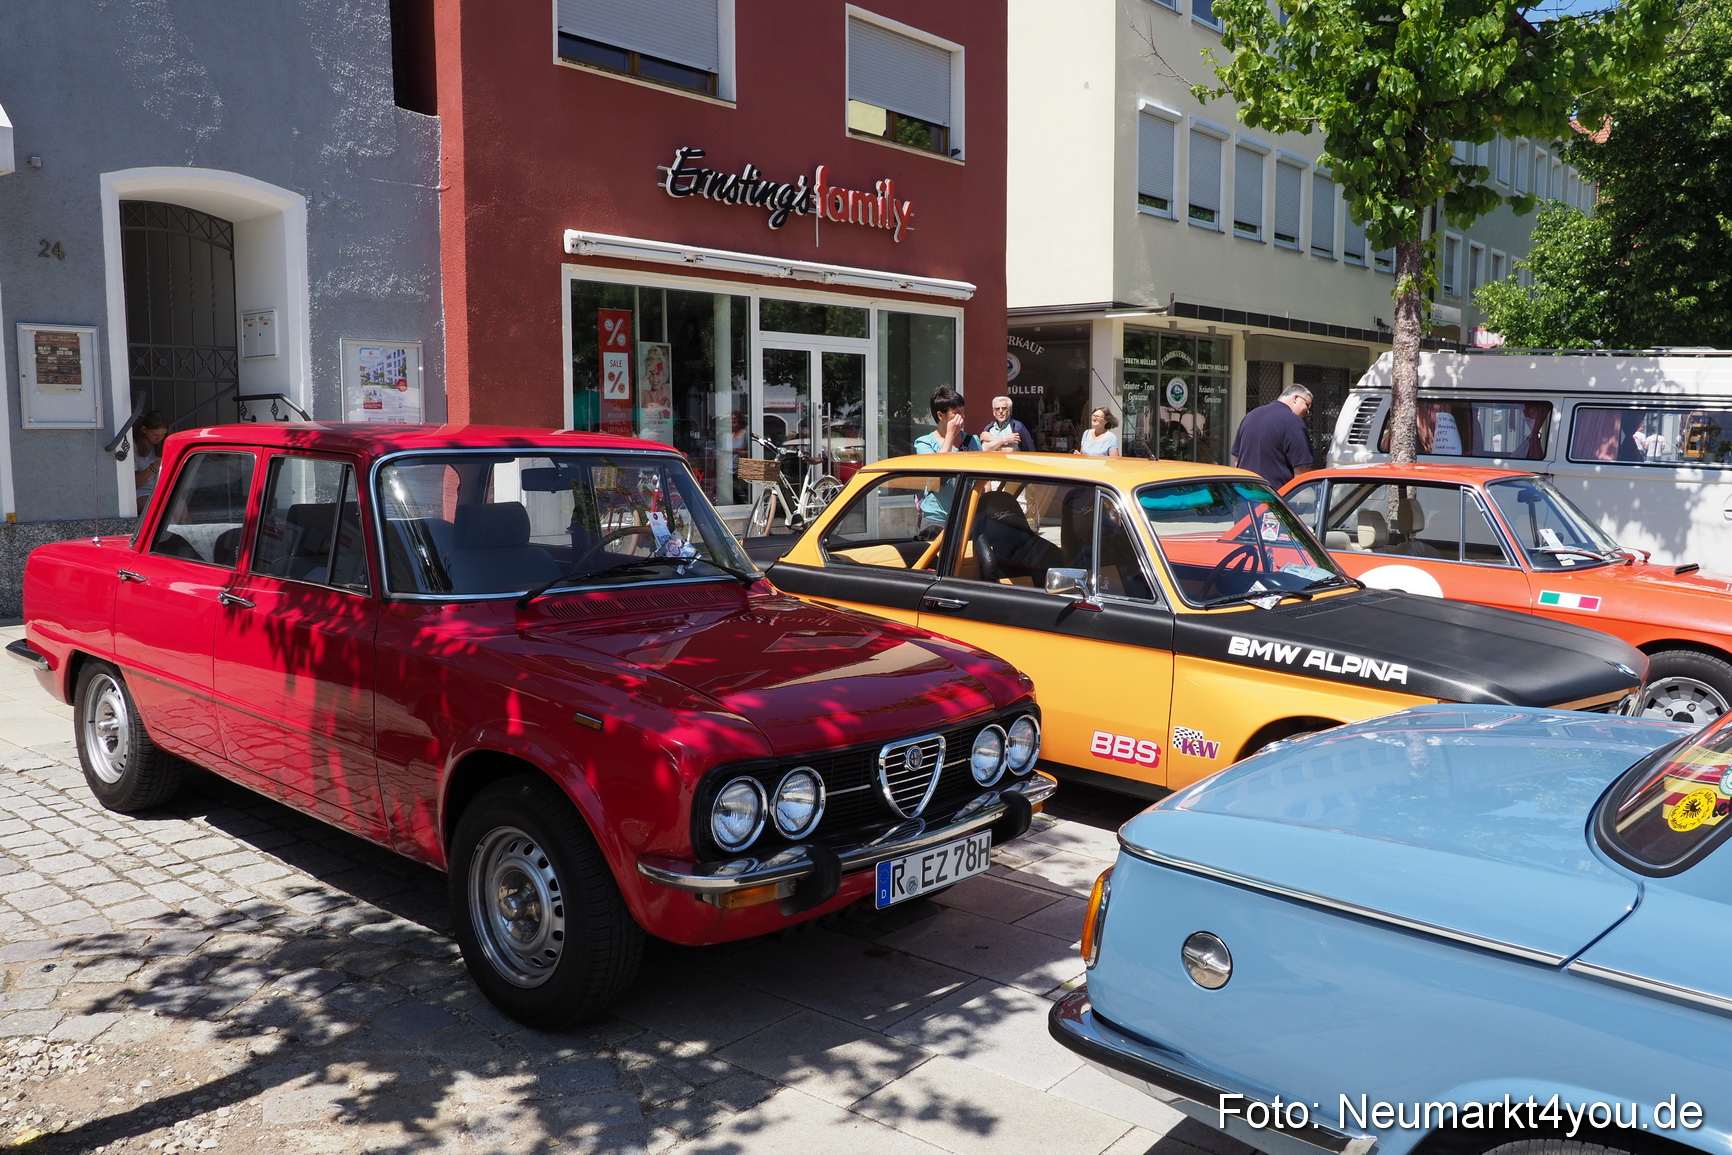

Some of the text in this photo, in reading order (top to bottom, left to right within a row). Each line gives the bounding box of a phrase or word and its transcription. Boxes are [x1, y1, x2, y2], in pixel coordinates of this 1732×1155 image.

[666, 147, 915, 243] Ernsting's family
[38, 239, 65, 261] 24
[1007, 335, 1045, 355] RKAUF
[609, 359, 623, 368] SALE
[1123, 357, 1157, 366] LSBETH MÜLLER
[1227, 635, 1409, 685] BMW ALPINA
[1090, 730, 1161, 767] BBS
[1181, 736, 1221, 760] KW
[891, 835, 991, 898] R EZ 78H
